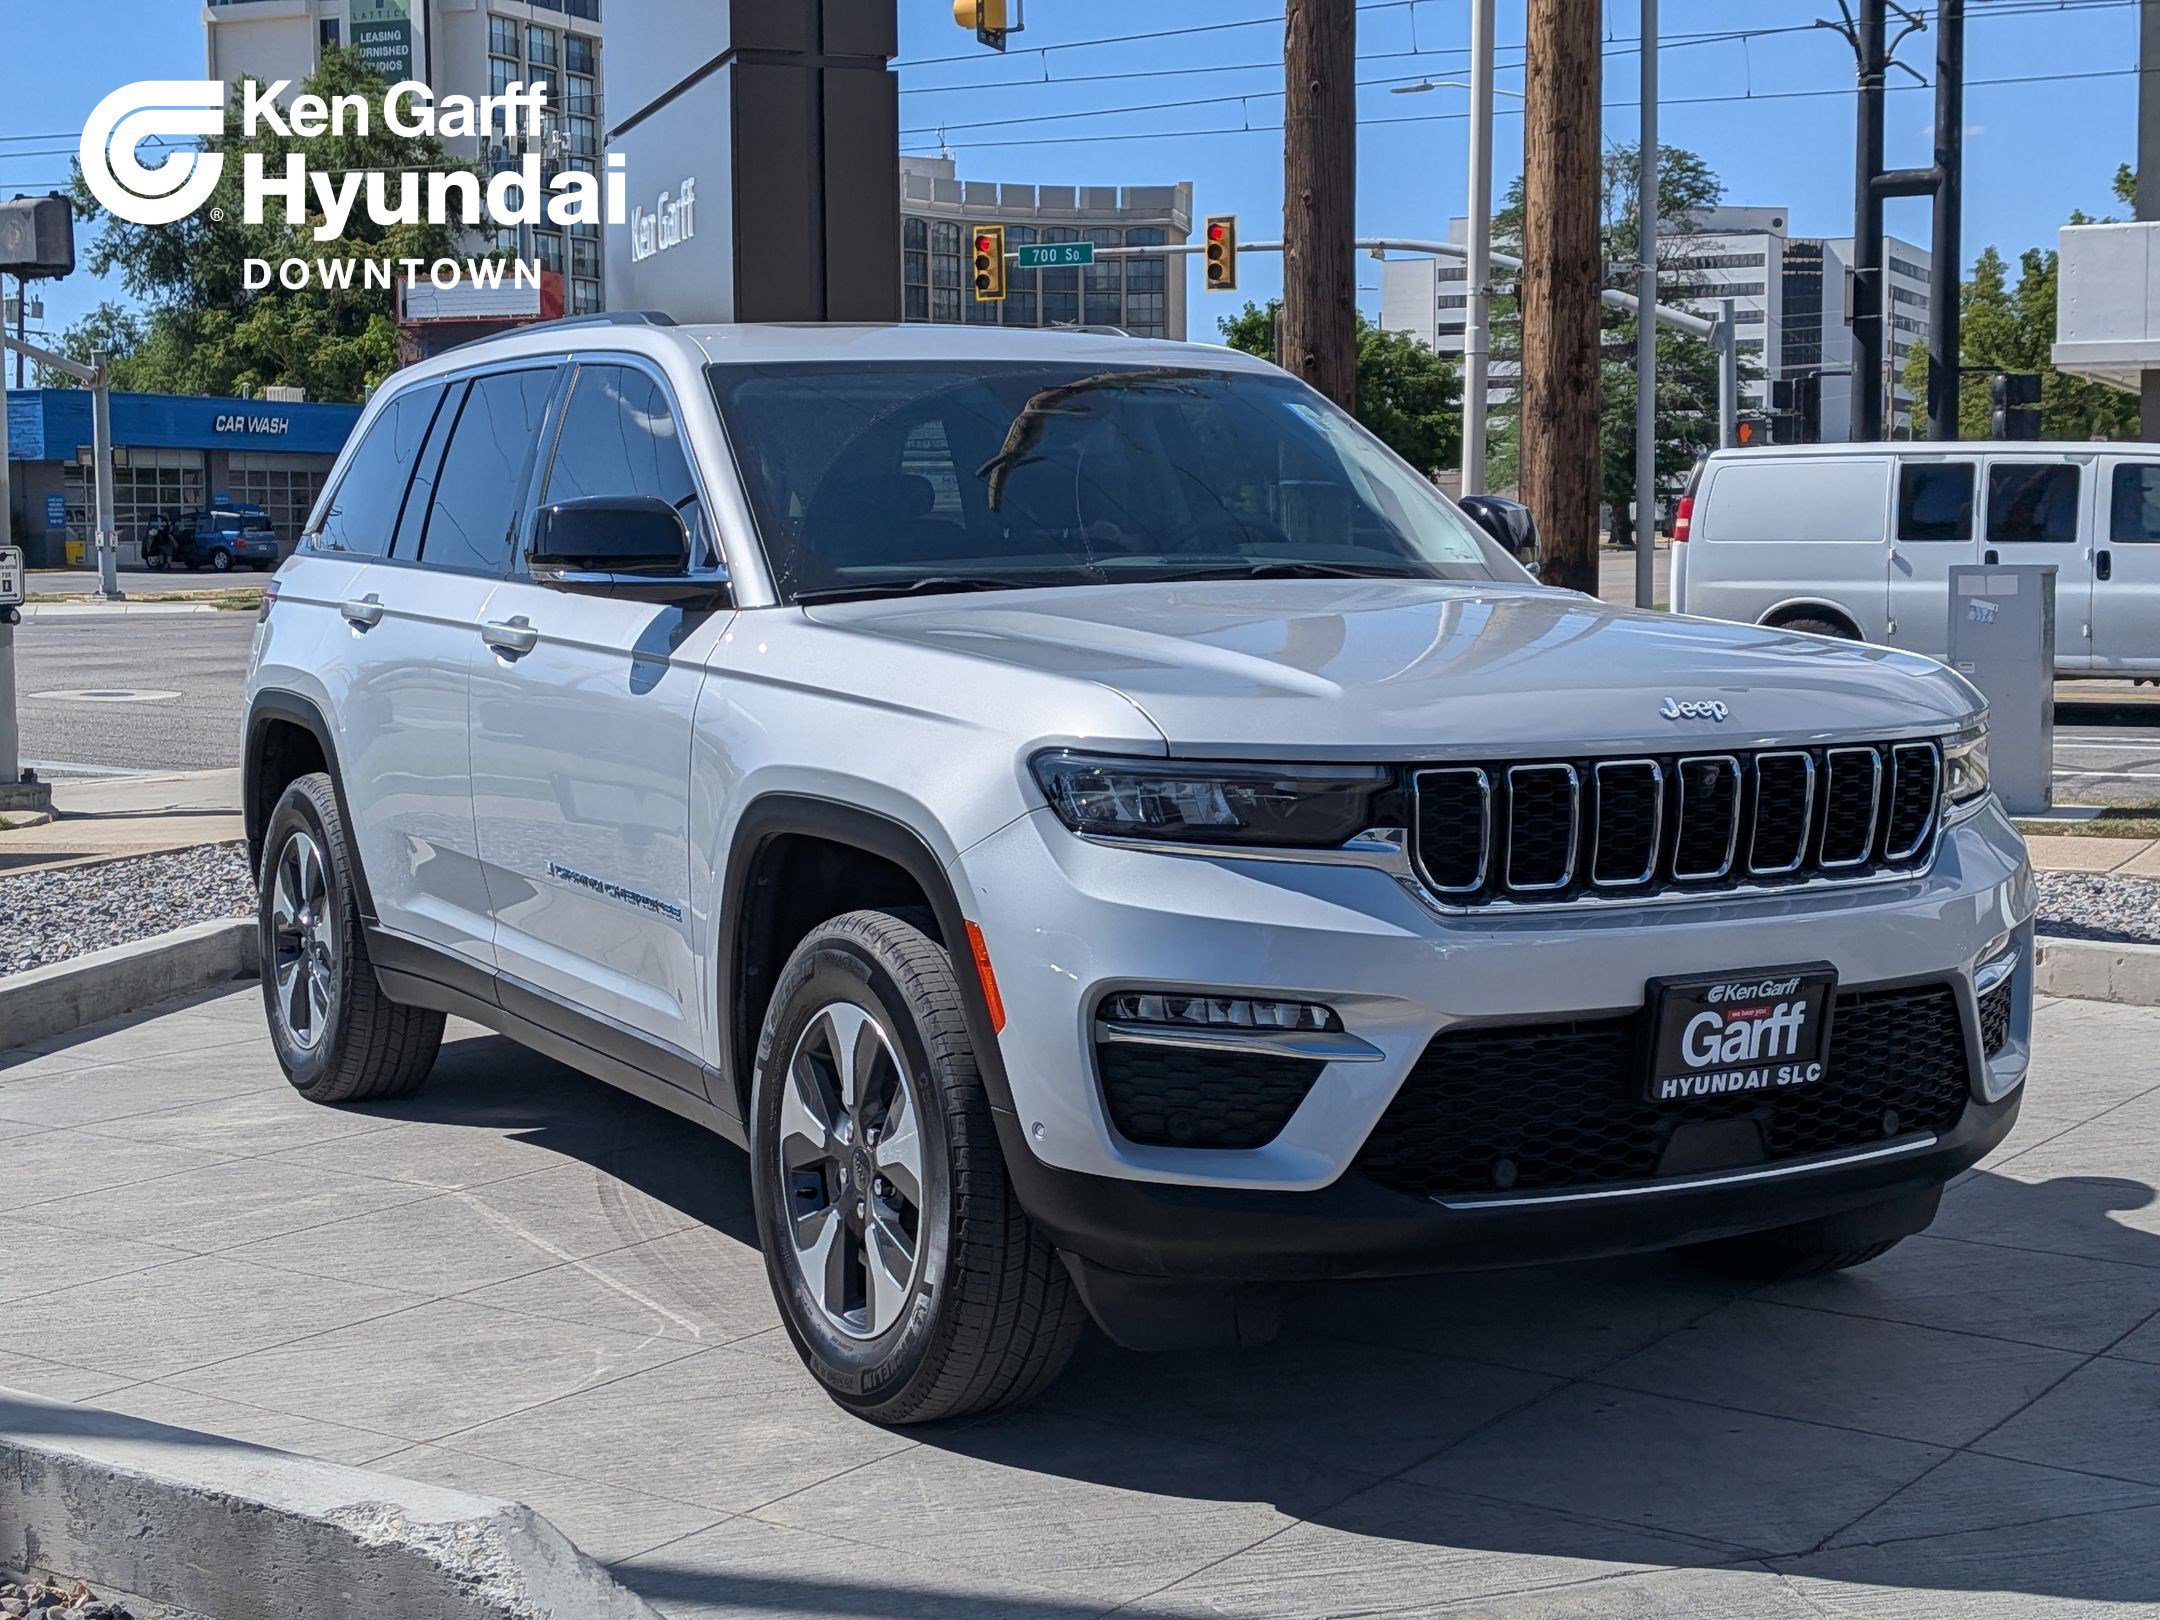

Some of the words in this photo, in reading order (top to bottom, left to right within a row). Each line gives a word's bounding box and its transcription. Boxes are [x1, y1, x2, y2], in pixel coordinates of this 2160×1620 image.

[360, 30, 401, 43] LEASING
[358, 45, 409, 58] URNISHED
[632, 206, 657, 262] Ken
[658, 177, 695, 250] Garff
[1032, 249, 1057, 262] 700
[216, 415, 245, 432] CAR
[248, 416, 289, 434] WASH
[1659, 697, 1729, 722] Jeep
[1724, 984, 1757, 1002] Ken
[1758, 977, 1801, 997] Garff
[1682, 1001, 1806, 1068] Garff
[1661, 1069, 1769, 1099] HYUNDAI
[1777, 1063, 1822, 1086] SLC
